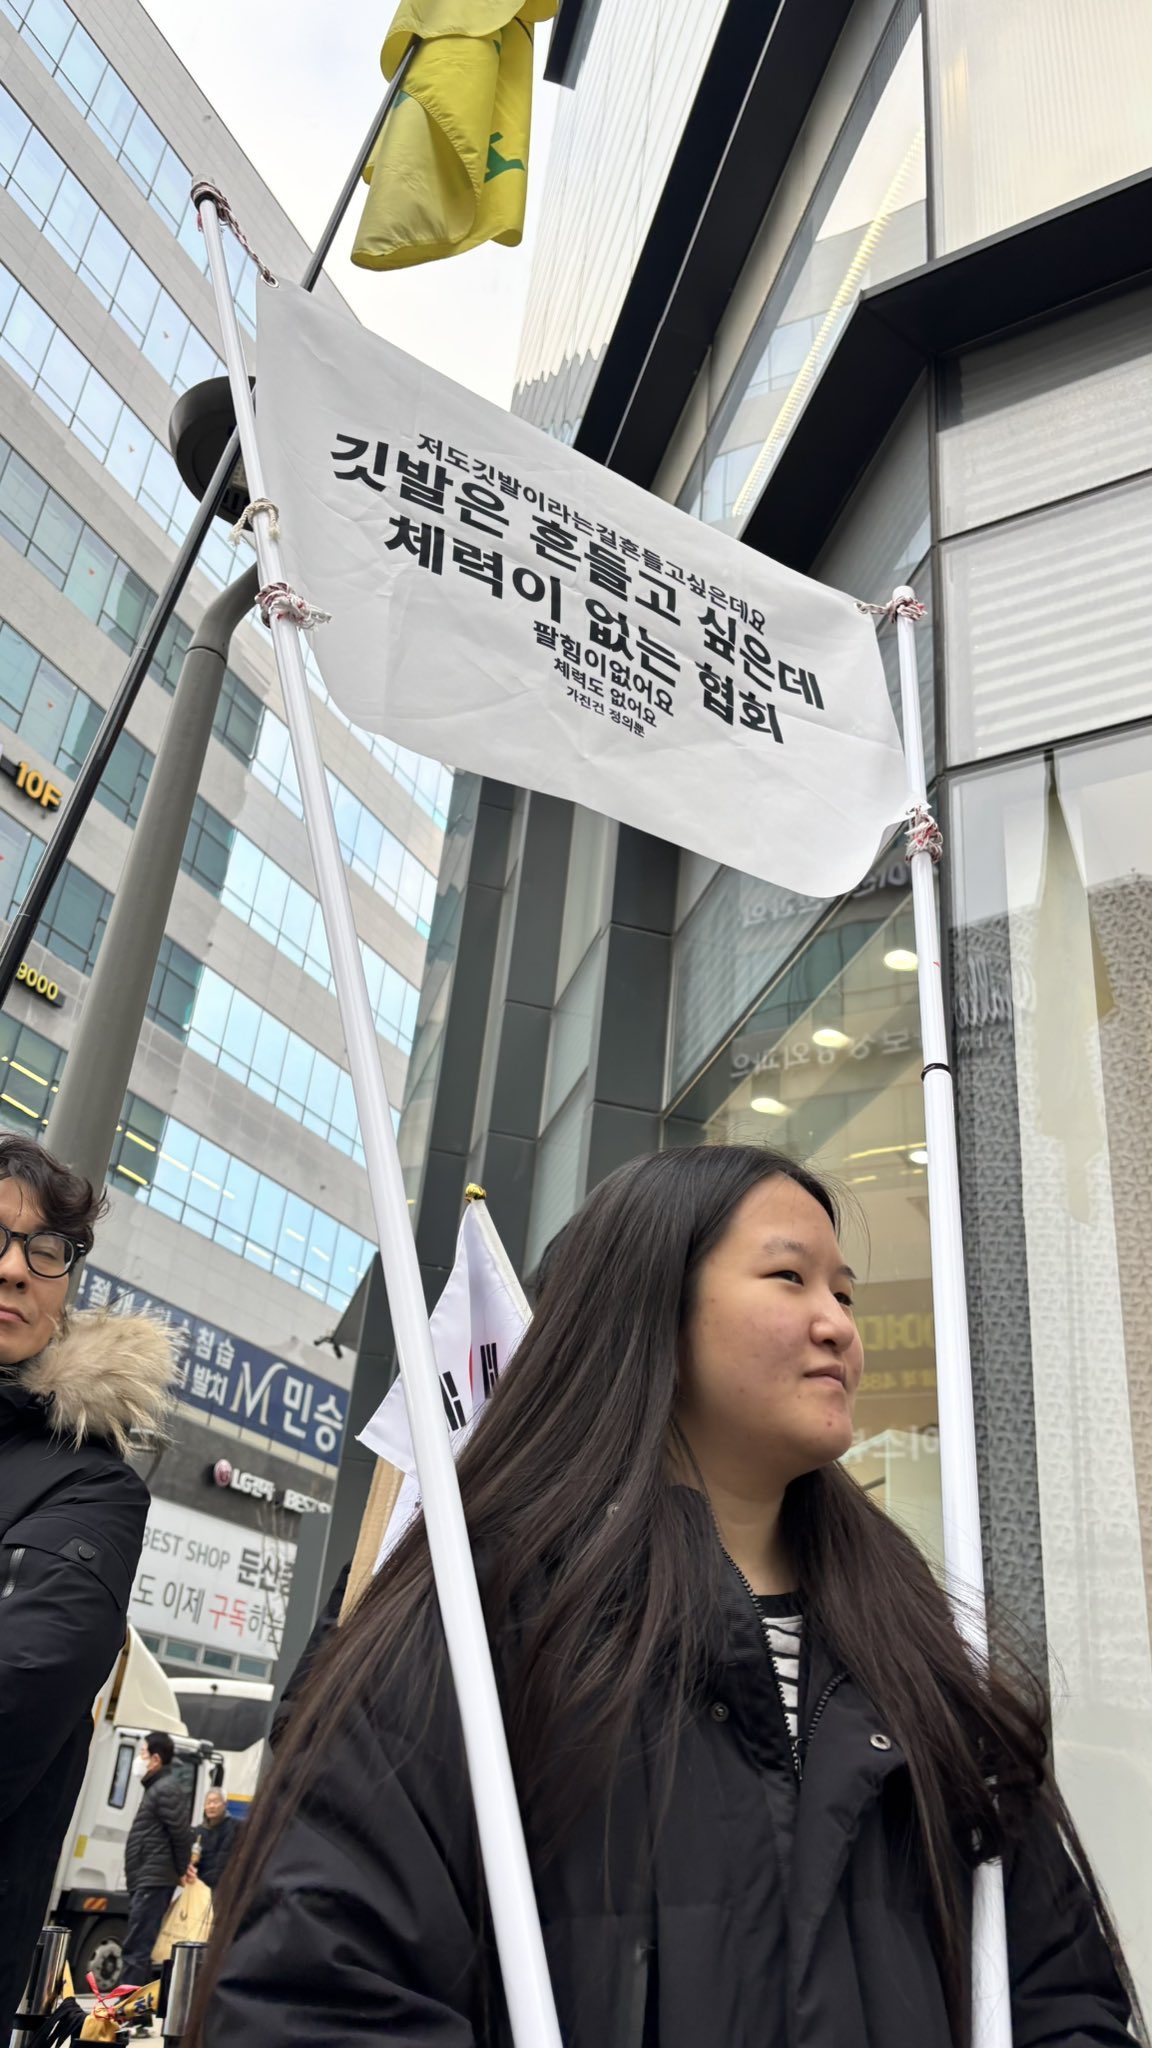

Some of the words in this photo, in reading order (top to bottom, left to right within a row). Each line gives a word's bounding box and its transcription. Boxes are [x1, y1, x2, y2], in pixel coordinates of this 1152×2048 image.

[417, 433, 766, 635] 저도깃발이라는걸흔들고싶은데요
[330, 433, 509, 539] 깃발은
[530, 514, 681, 627] 흔들고
[698, 606, 825, 710] 싶은데
[384, 514, 562, 624] 체력이
[585, 598, 681, 688] 없는
[694, 660, 784, 744] 협회
[533, 620, 674, 717] 팔힘이없어요
[554, 658, 604, 698] 체력도
[610, 688, 657, 728] 없어요
[566, 685, 605, 716] 가진건
[608, 708, 646, 738] 정의뿐
[16, 761, 63, 807] 10F
[186, 1539, 231, 1571] SHOP
[162, 1581, 206, 1625] 이제
